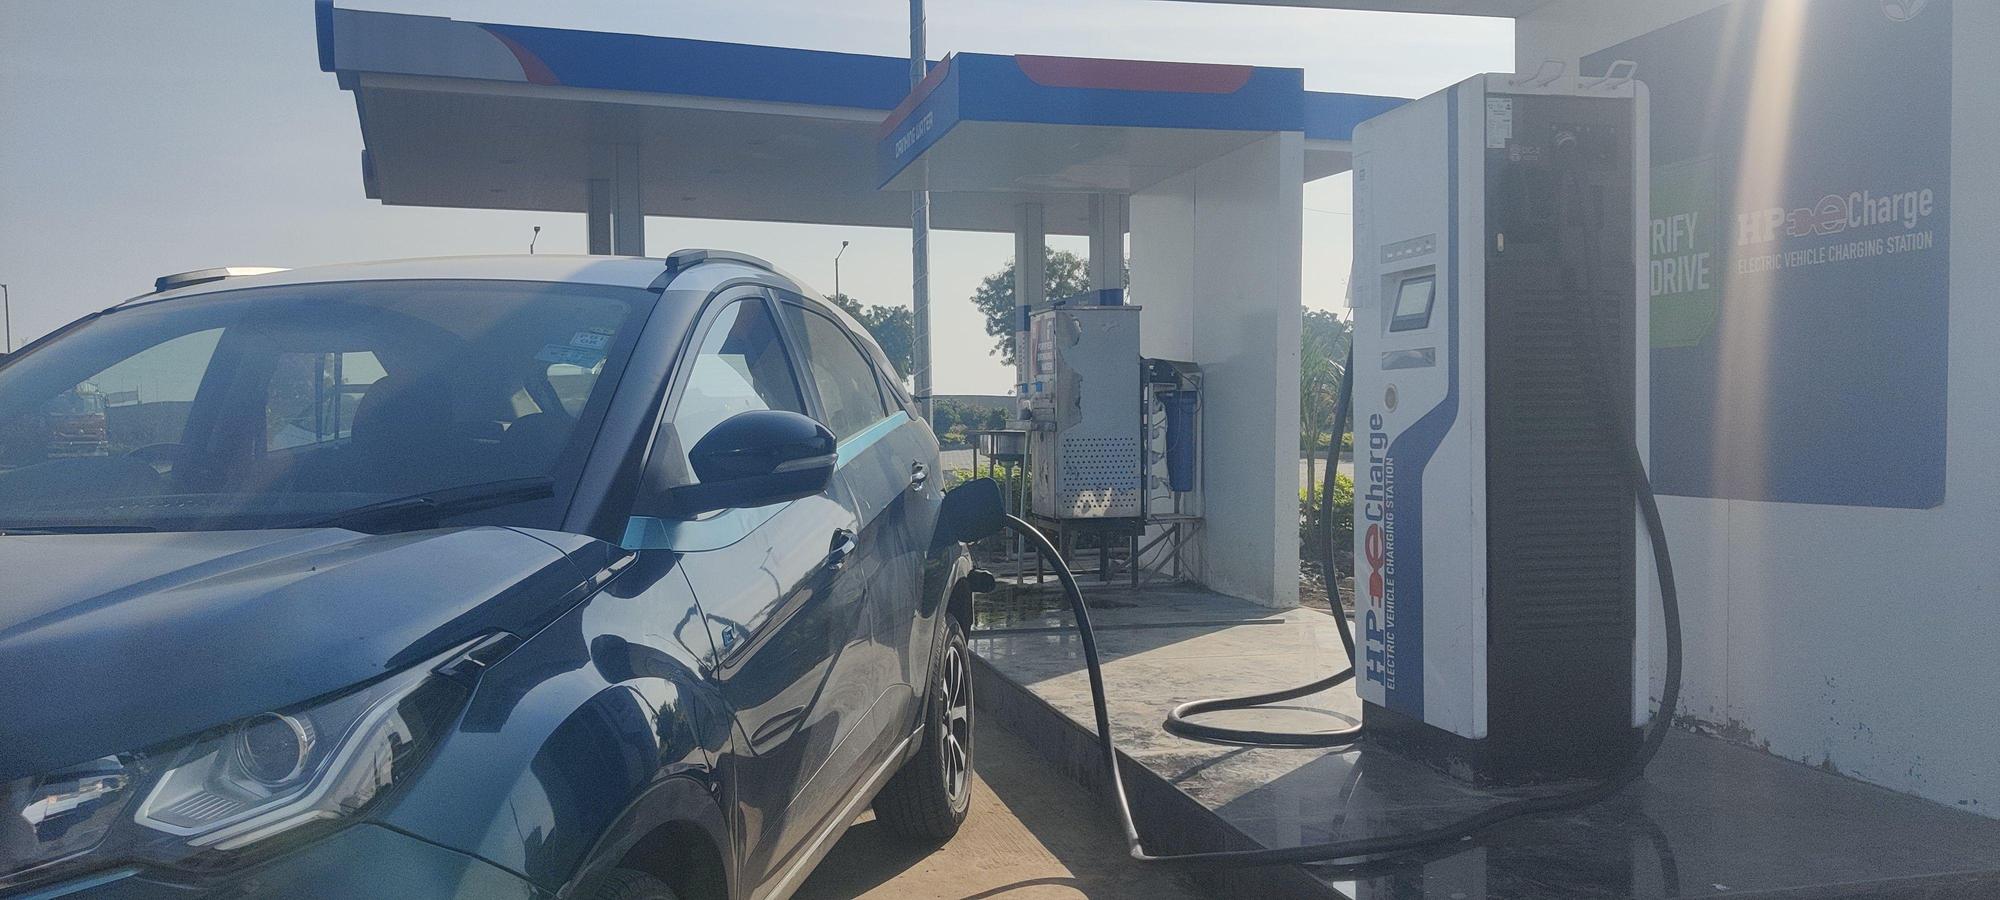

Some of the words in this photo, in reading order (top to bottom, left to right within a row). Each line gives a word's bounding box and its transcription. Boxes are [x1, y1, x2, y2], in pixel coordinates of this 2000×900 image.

[1650, 212, 1698, 255] RIFY
[1738, 207, 1785, 246] HP
[1651, 252, 1709, 296] DRIVE
[1738, 254, 1781, 275] ELECTRIC
[1784, 247, 1825, 267] VEHICLE
[1828, 239, 1883, 262] CHARGING
[1886, 231, 1933, 254] STATION
[1386, 457, 1394, 508] STATION
[1386, 514, 1395, 575] CHARGING
[1386, 578, 1395, 630] VEHICLE
[1366, 609, 1385, 686] HP
[1386, 633, 1395, 690] ELECTRIC
